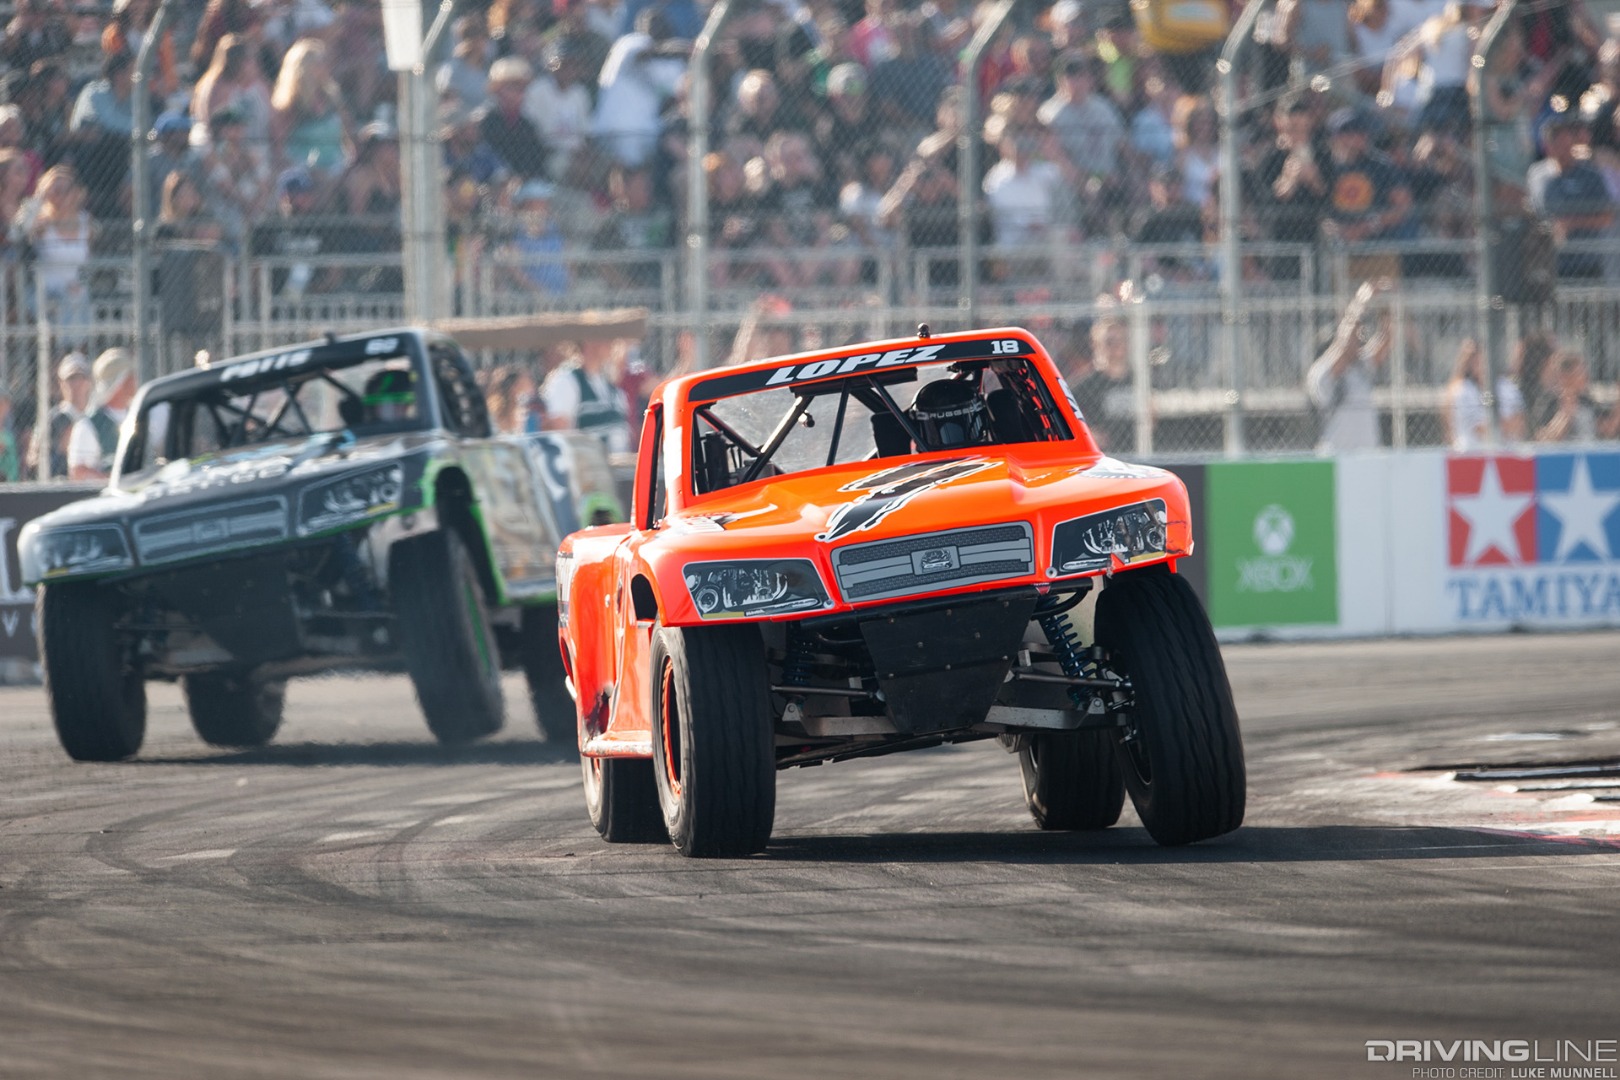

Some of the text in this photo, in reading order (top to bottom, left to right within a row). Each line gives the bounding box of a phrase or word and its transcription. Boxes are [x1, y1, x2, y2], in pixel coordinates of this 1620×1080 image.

[765, 344, 946, 386] LOPEZ
[991, 340, 1019, 354] 18
[1235, 556, 1315, 592] XBOX
[1447, 574, 1620, 619] TAMIYA
